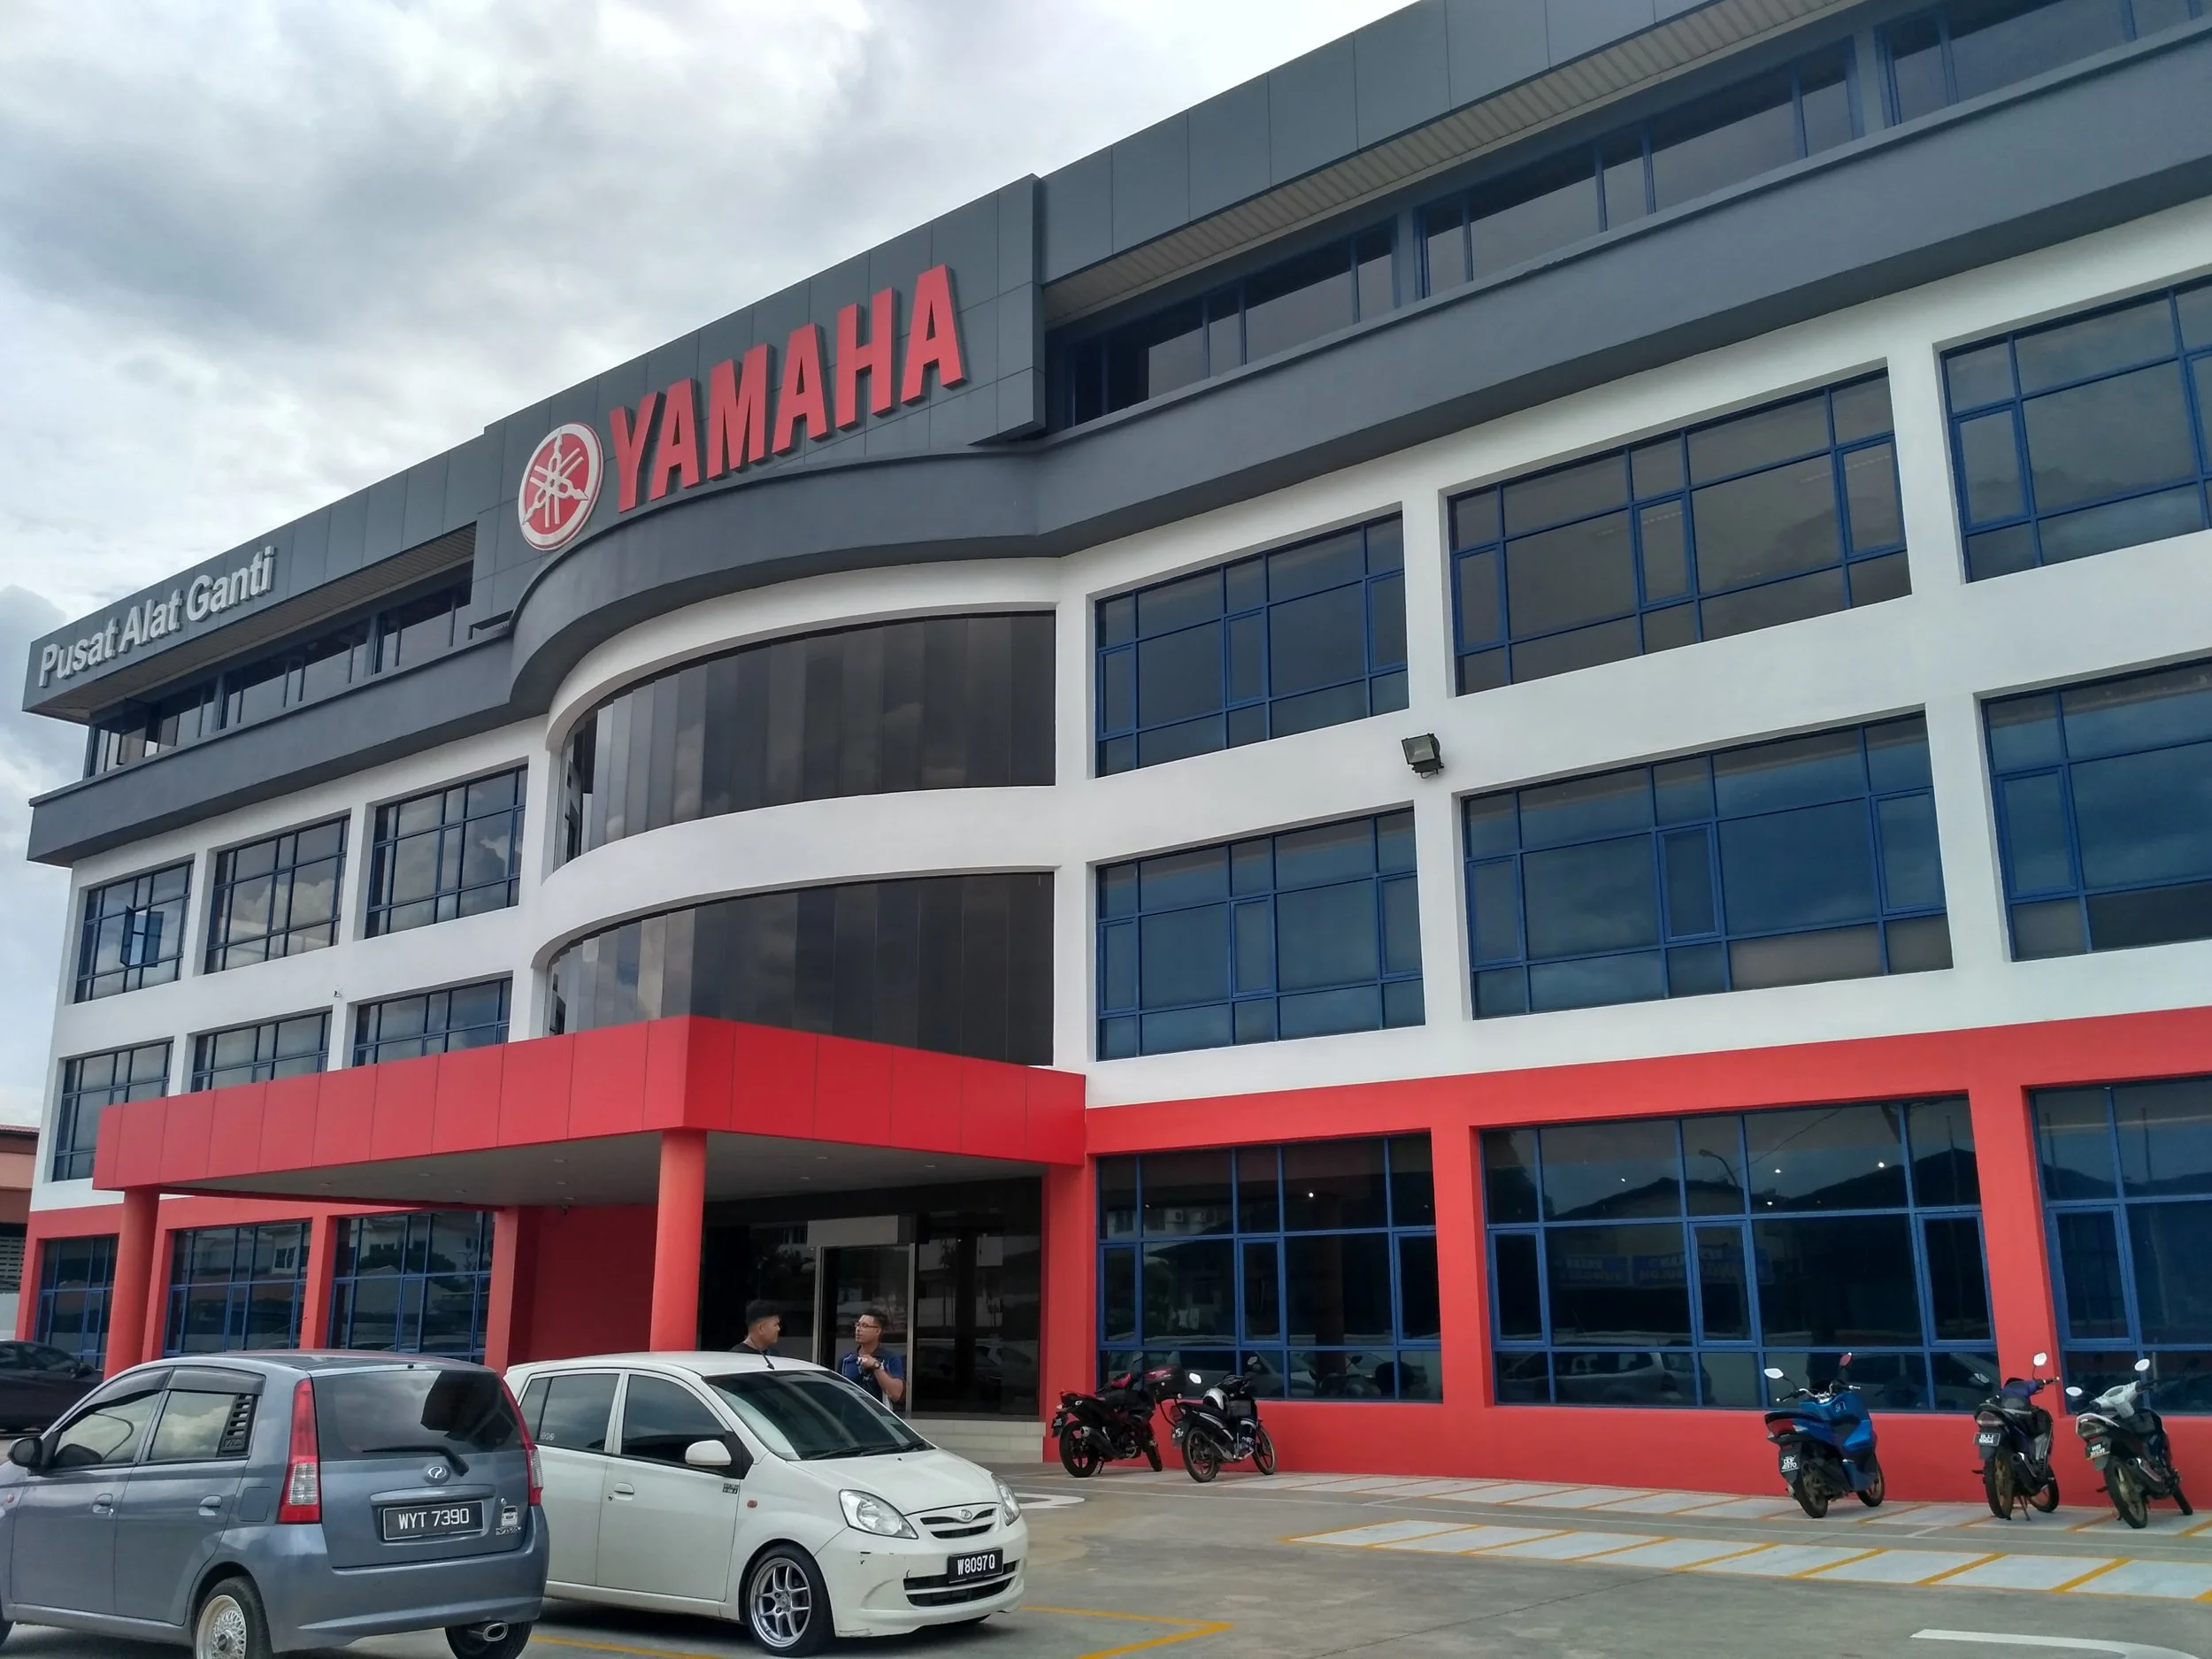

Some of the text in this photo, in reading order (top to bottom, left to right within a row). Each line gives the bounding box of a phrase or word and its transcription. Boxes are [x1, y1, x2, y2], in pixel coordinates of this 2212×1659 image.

[610, 264, 968, 513] YAMAHA
[38, 545, 276, 687] Pusat Alat Ganti
[398, 1508, 470, 1530] WYT 7390
[957, 1554, 995, 1575] W8097Q
